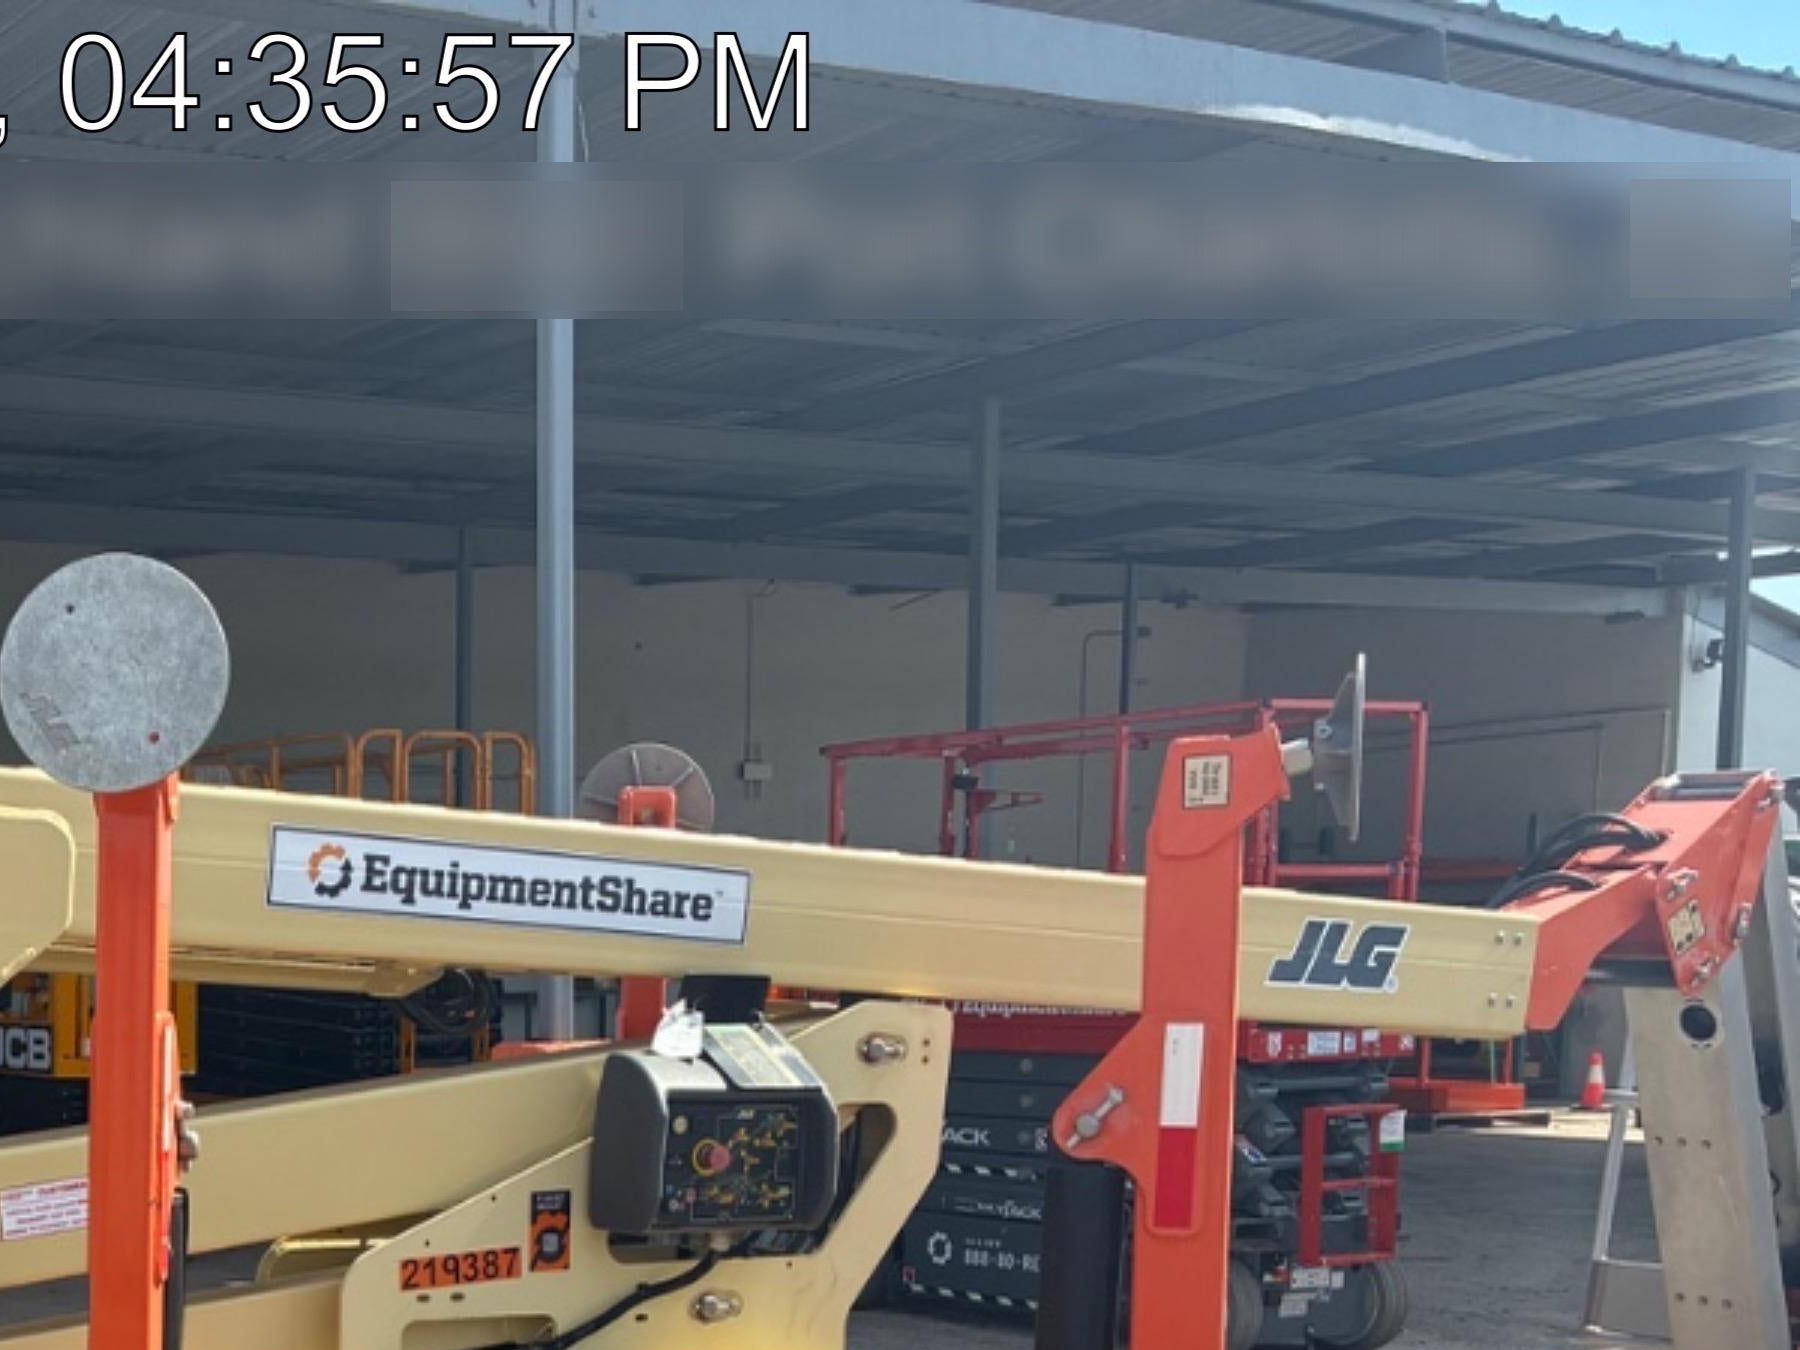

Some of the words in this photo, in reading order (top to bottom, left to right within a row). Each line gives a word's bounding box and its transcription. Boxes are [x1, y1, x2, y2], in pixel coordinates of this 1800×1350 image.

[360, 852, 715, 922] EquipmentShare
[1264, 916, 1410, 991] JLG
[401, 1247, 521, 1291] 219387
